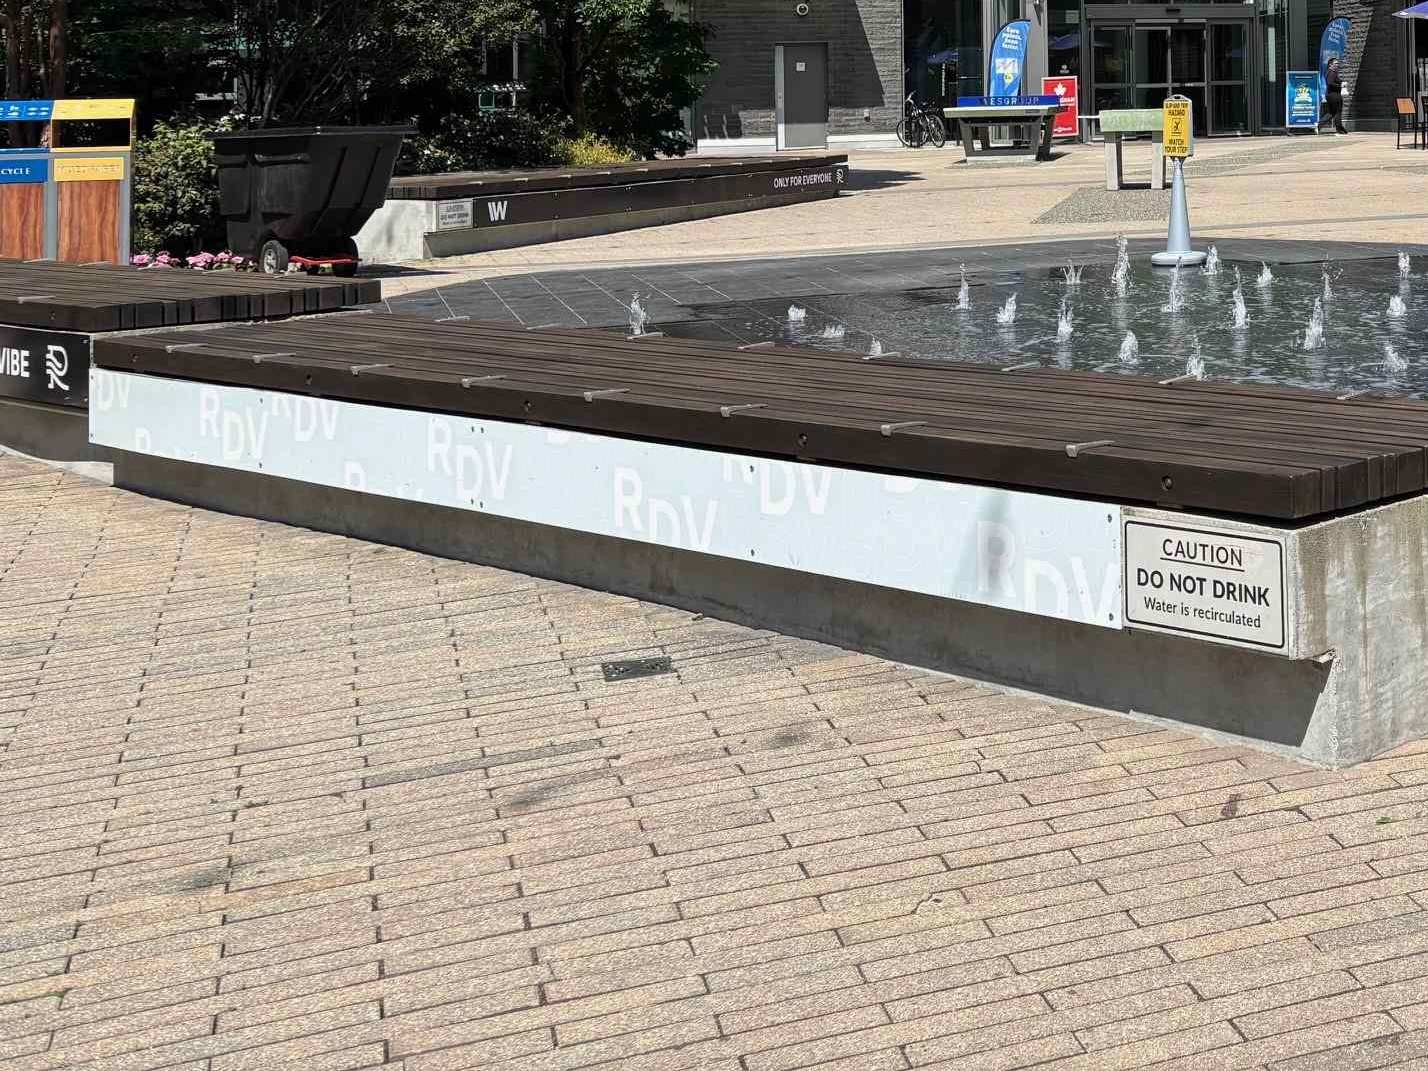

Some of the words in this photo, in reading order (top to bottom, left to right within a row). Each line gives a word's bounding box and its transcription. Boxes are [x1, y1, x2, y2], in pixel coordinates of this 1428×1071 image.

[773, 177, 789, 188] ONLY
[790, 175, 802, 187] FOR
[803, 172, 832, 185] EVERYONE
[427, 416, 513, 504] RDV
[1163, 538, 1243, 567] CAUTION
[1137, 567, 1164, 589] DO
[1169, 572, 1207, 596] NOT
[1212, 579, 1270, 607] DRINK
[1144, 596, 1178, 614] Water
[1181, 602, 1190, 617] is
[1193, 607, 1262, 628] recirculated
